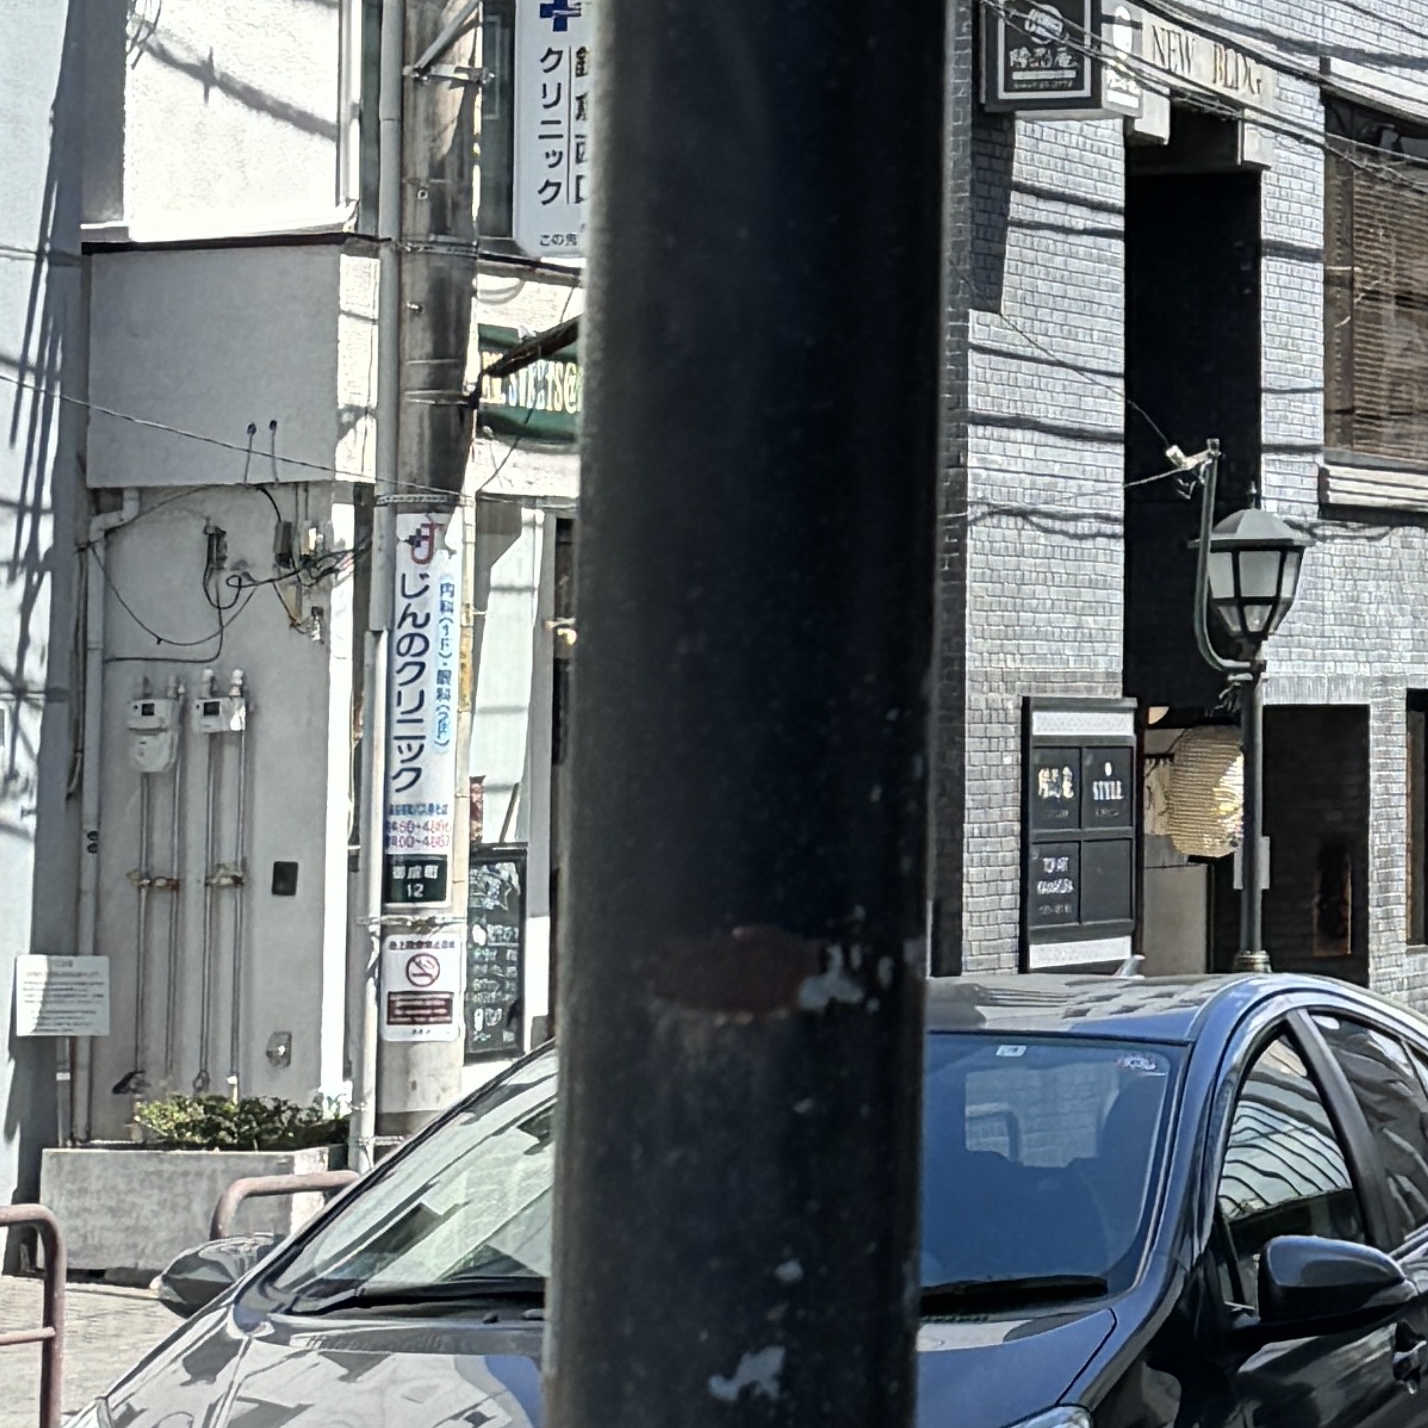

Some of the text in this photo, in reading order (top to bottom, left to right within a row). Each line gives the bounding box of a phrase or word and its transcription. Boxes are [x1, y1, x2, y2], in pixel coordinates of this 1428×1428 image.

[1152, 25, 1196, 73] NEW
[538, 47, 564, 205] クリニック
[392, 573, 431, 793] じんのクリニック
[407, 883, 425, 898] 12
